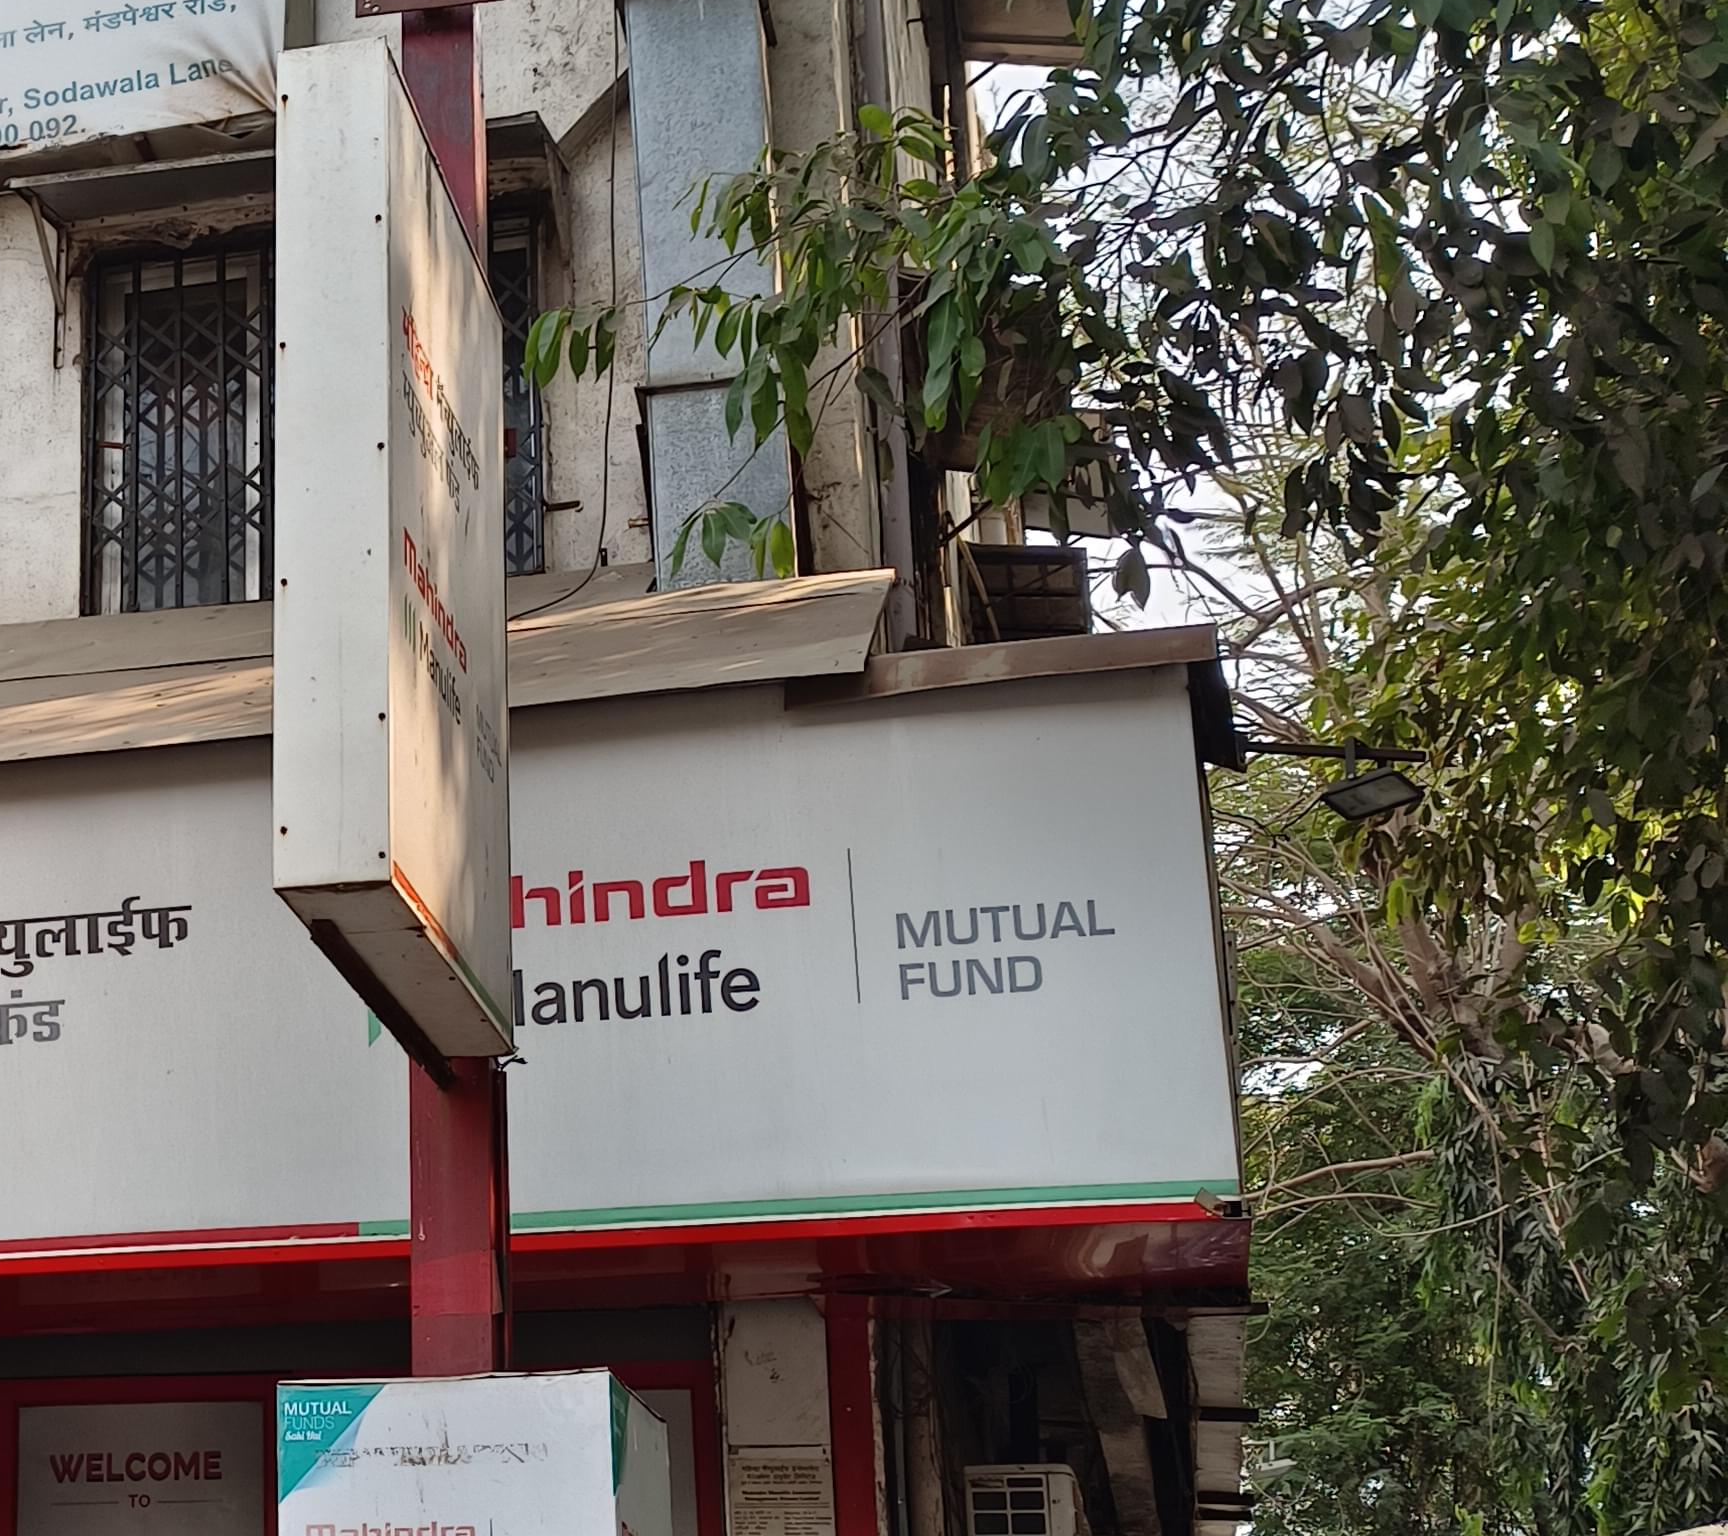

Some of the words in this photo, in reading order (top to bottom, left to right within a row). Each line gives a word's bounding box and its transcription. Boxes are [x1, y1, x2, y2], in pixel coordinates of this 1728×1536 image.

[23, 19, 75, 45] लेन,
[82, 0, 178, 33] मंडपेश्वर
[22, 69, 161, 111] Sodawala
[419, 620, 461, 726] Manulife
[511, 860, 812, 930] hindra
[894, 899, 1117, 951] MUTUAL
[898, 955, 1044, 1003] FUND
[284, 1400, 353, 1417] MUTUAL
[284, 1415, 335, 1431] FUNDS
[49, 1450, 223, 1484] WELCOME
[128, 1494, 151, 1509] TO
